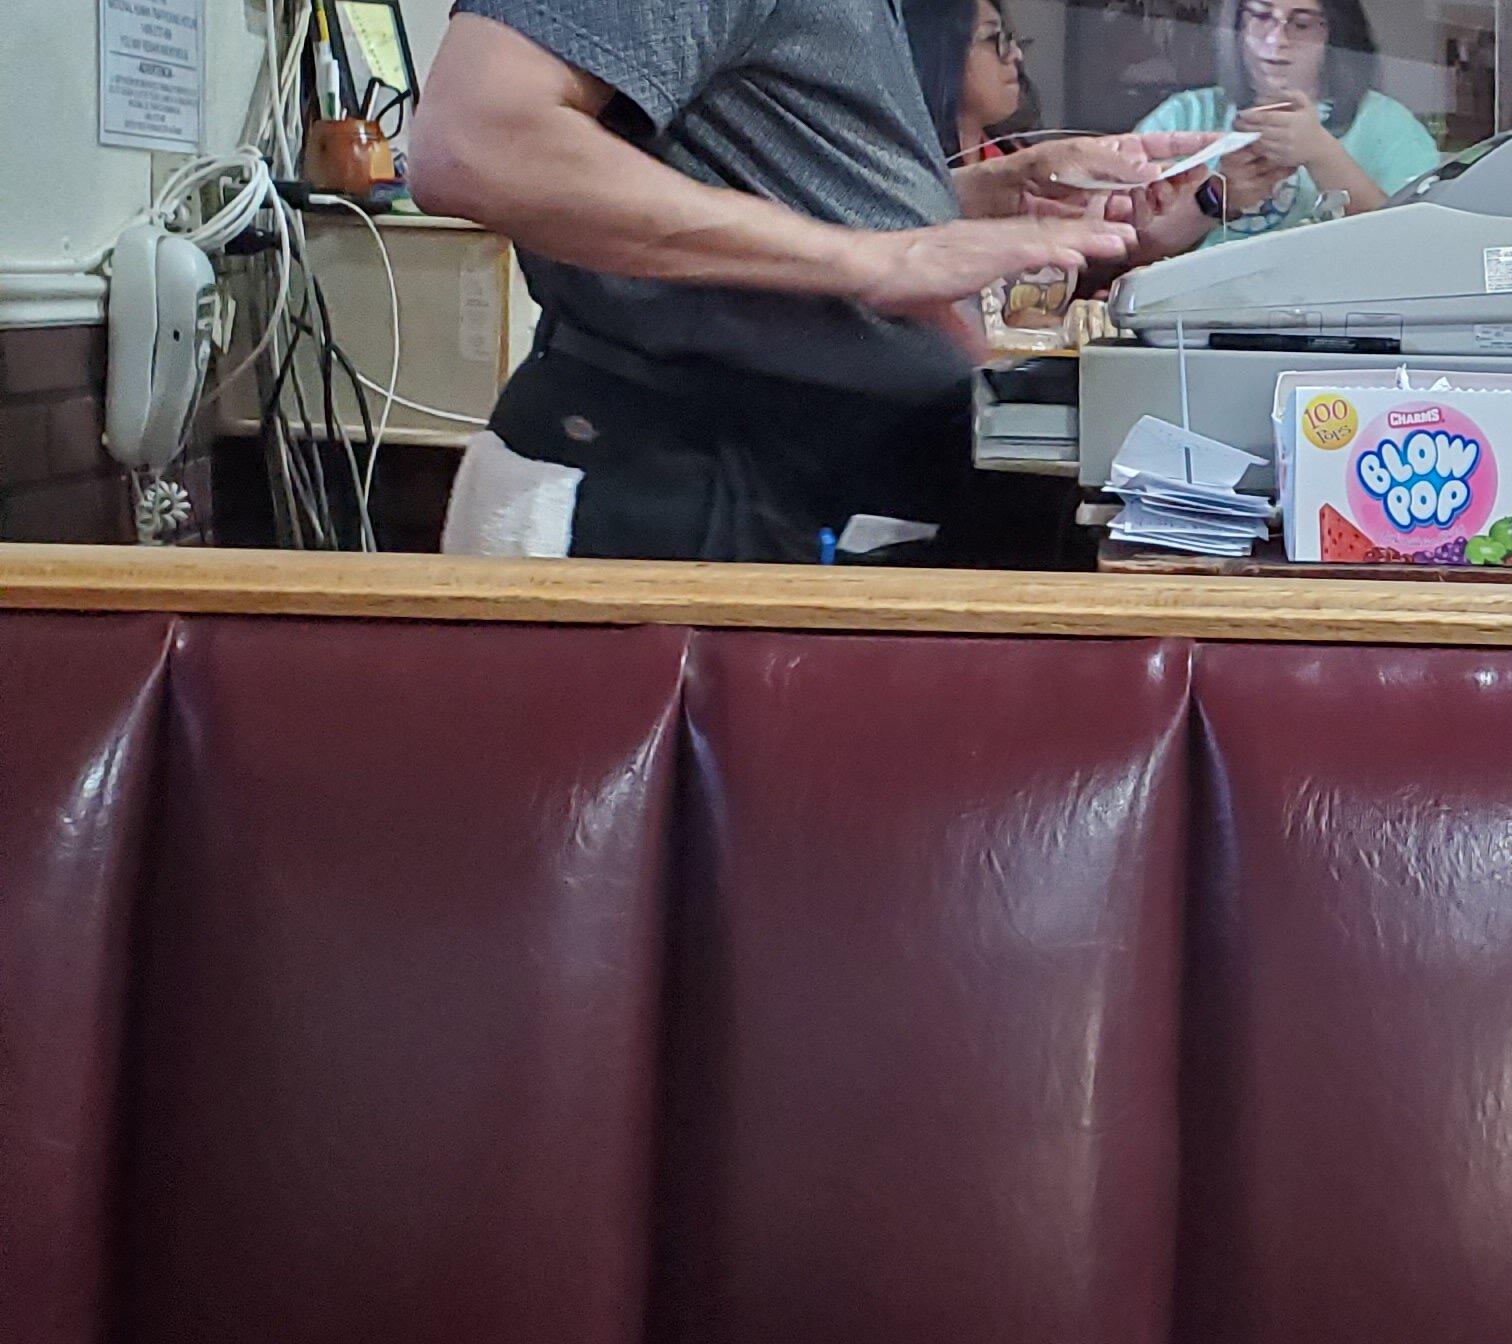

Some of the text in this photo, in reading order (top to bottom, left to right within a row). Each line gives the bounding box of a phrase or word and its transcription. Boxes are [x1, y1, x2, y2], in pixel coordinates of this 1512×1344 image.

[1303, 399, 1349, 431] 100
[1389, 408, 1440, 426] CHARMS
[1358, 431, 1479, 496] BLOW
[1385, 478, 1470, 528] POP
